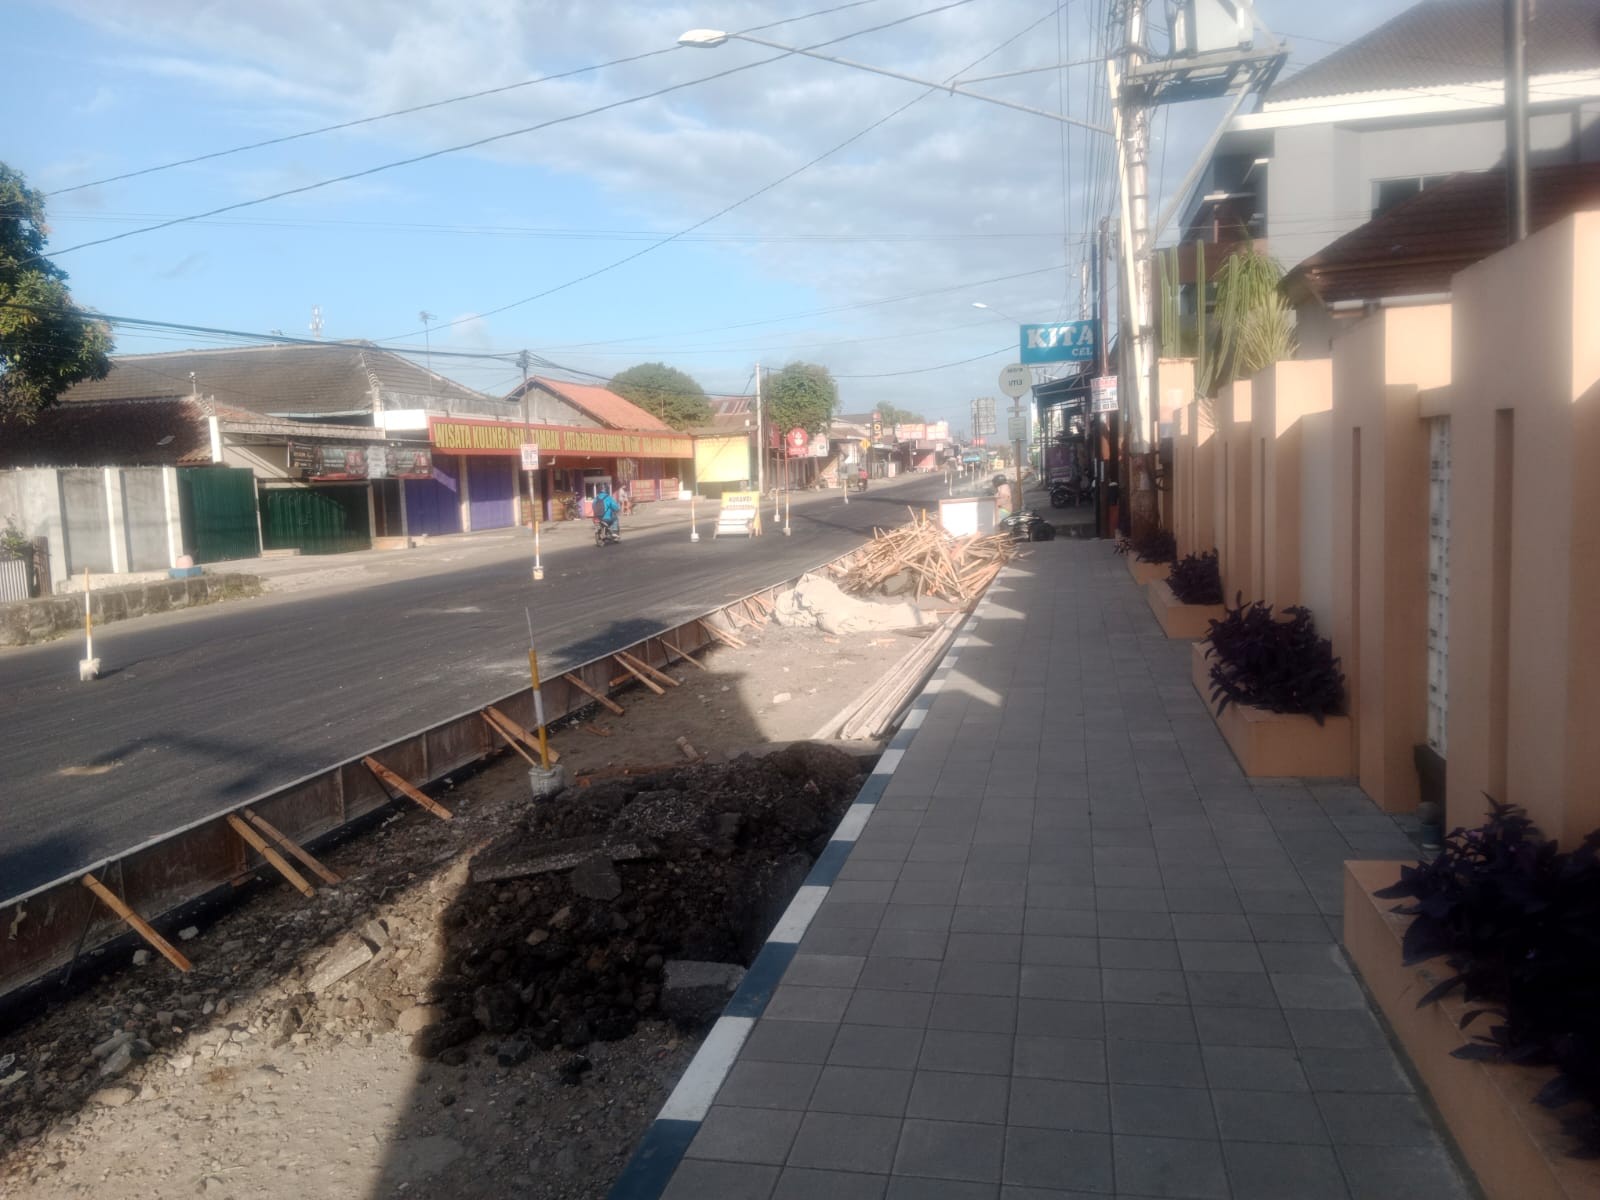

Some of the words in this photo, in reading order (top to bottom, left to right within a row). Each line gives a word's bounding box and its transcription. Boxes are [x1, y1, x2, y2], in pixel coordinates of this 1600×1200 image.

[1027, 325, 1093, 348] KITA
[434, 423, 471, 449] WISATA
[473, 426, 509, 449] KULINER
